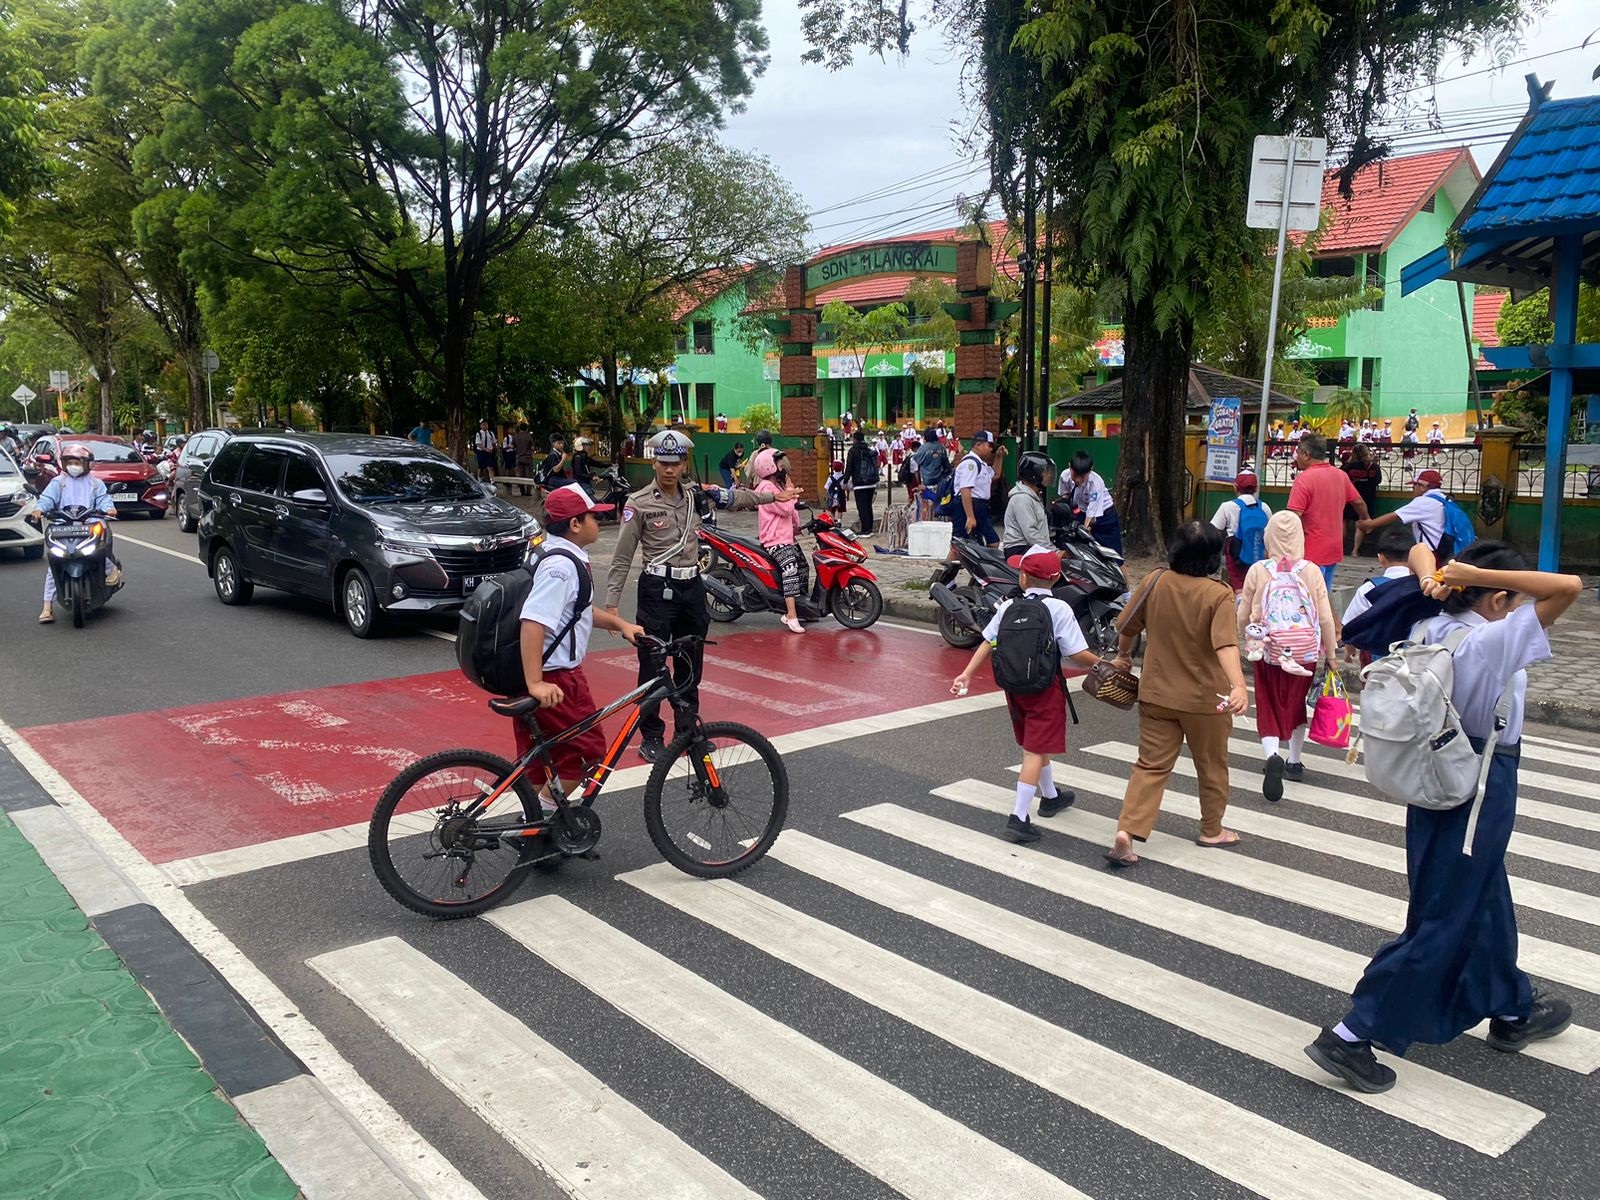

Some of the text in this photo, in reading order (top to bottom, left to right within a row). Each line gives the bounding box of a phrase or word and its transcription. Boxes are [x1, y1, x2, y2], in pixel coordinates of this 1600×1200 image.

[821, 259, 849, 281] SDN
[874, 249, 939, 269] LANGKAI
[464, 577, 474, 587] KH
